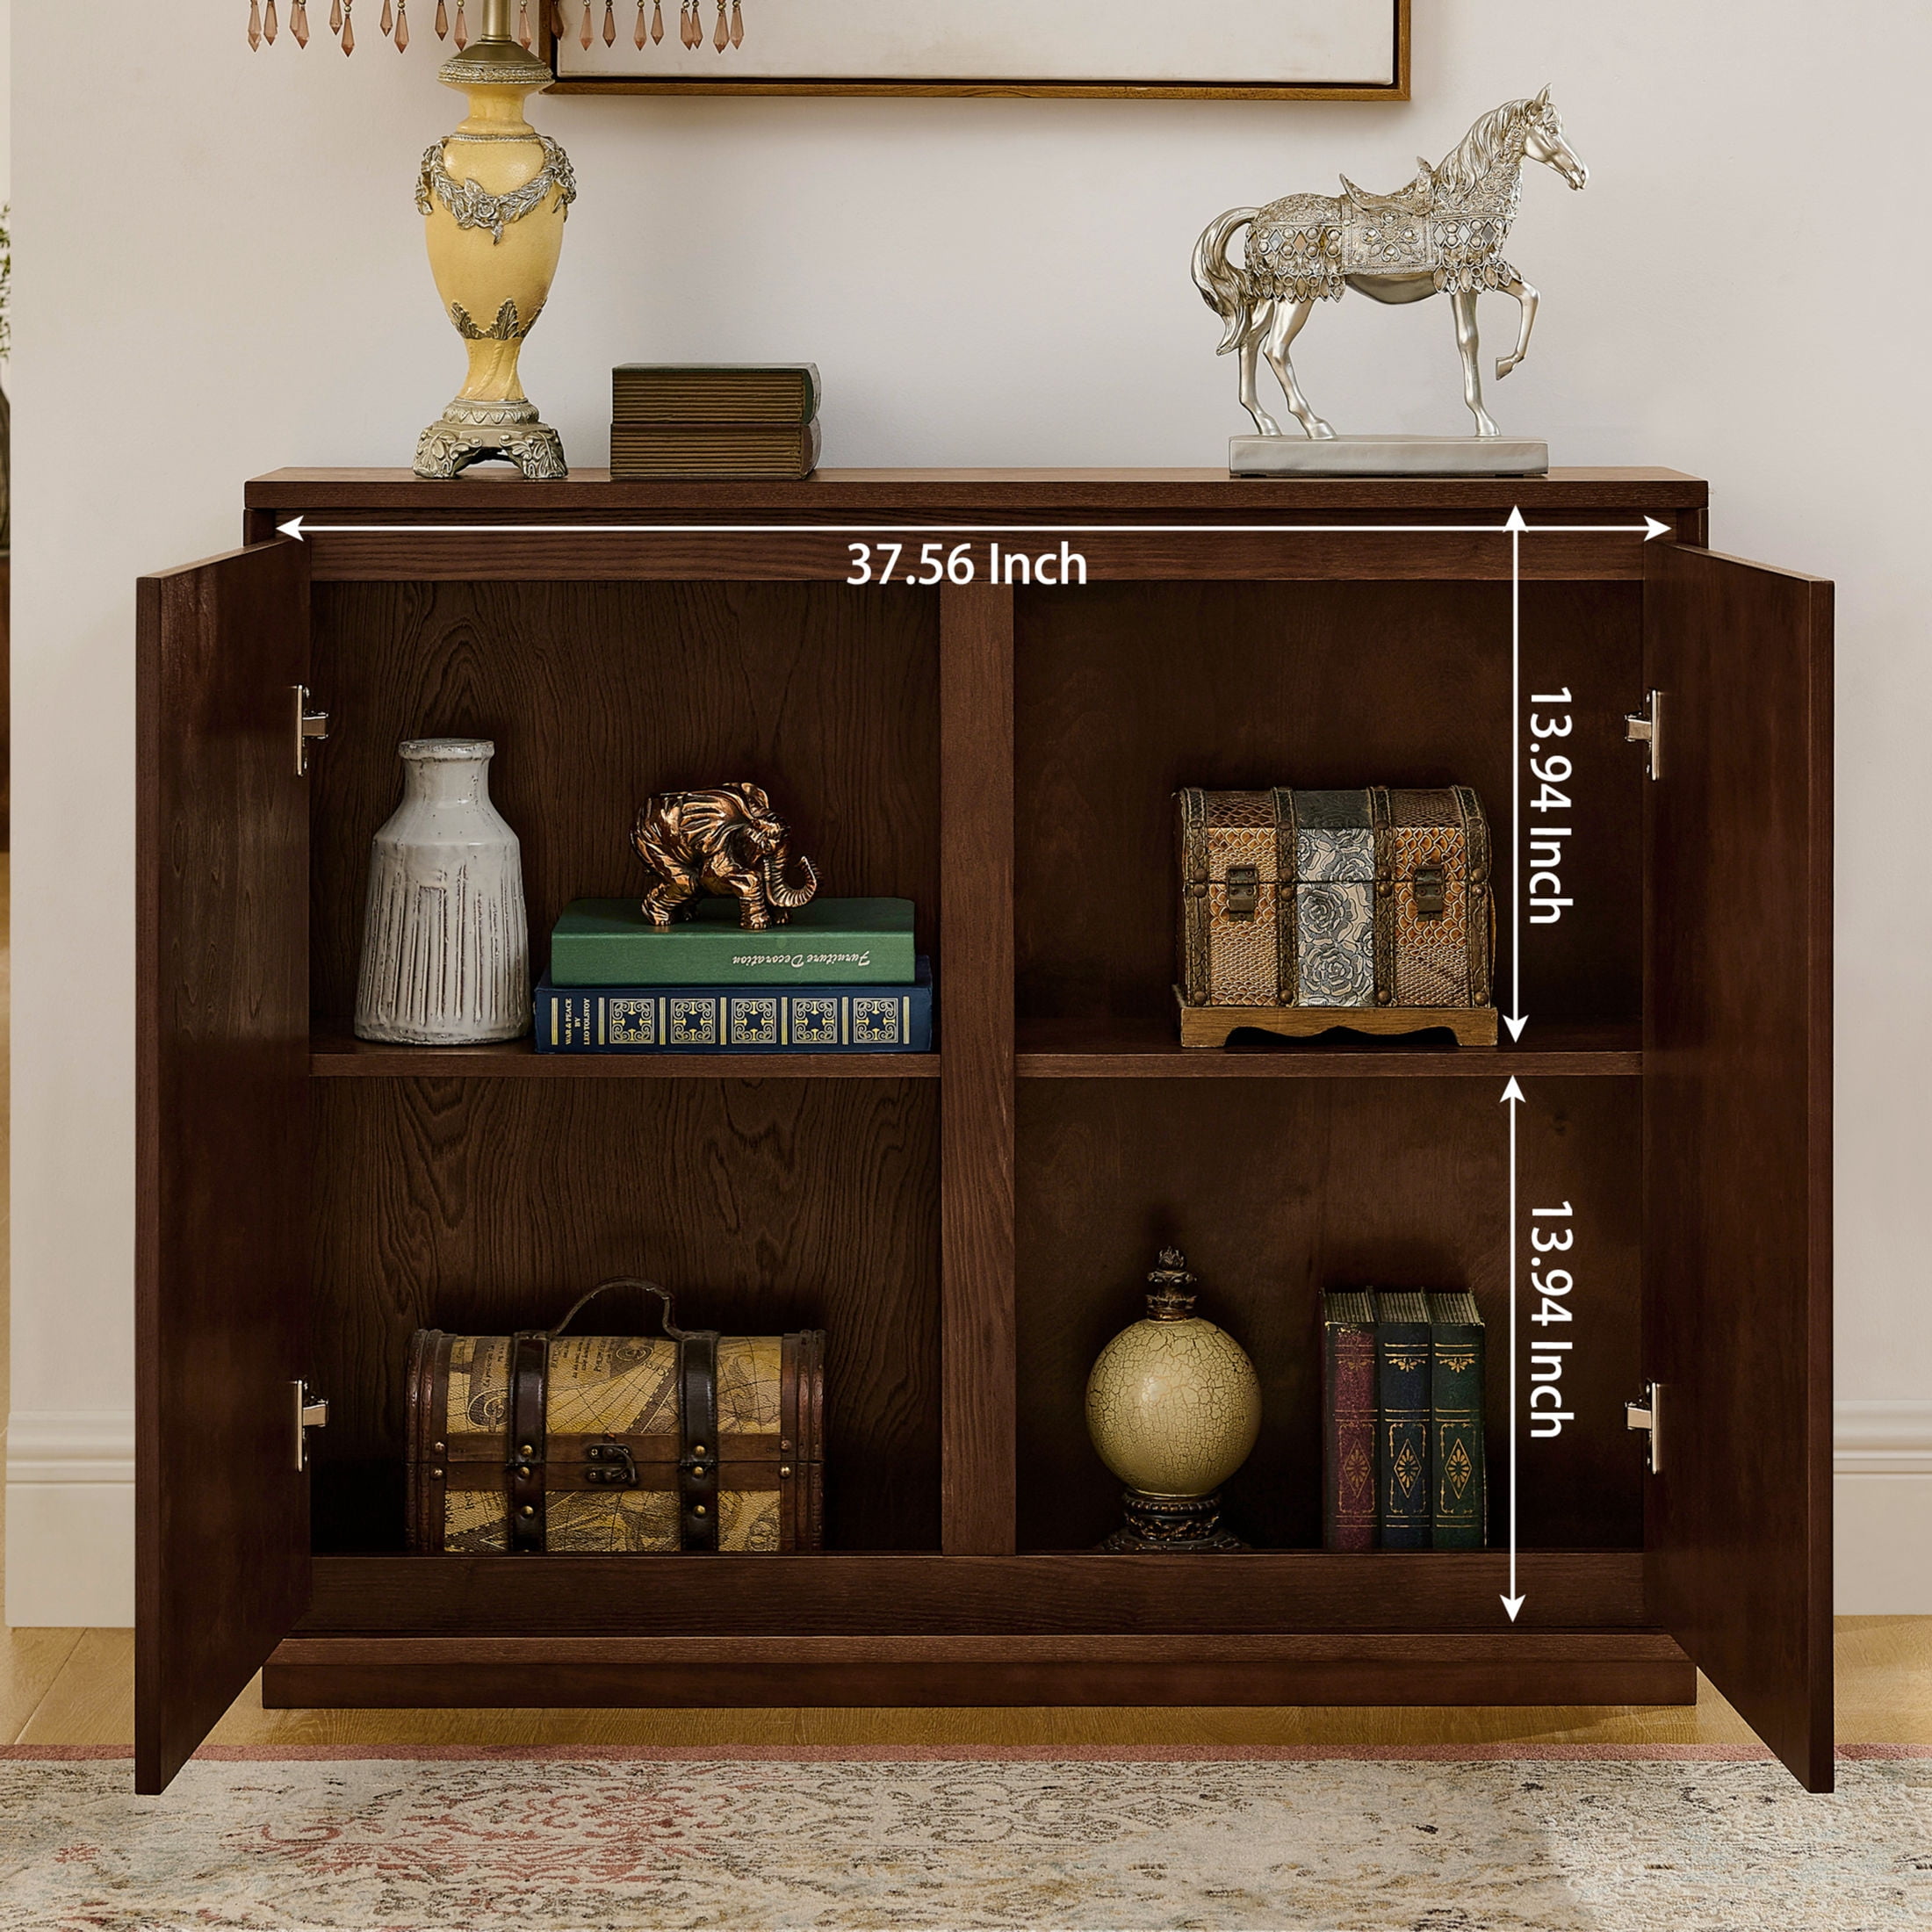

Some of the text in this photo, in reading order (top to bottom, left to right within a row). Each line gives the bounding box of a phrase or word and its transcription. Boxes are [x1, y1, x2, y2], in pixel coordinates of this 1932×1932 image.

[732, 950, 871, 969] Furniture Decoration
[574, 1017, 580, 1027] BY
